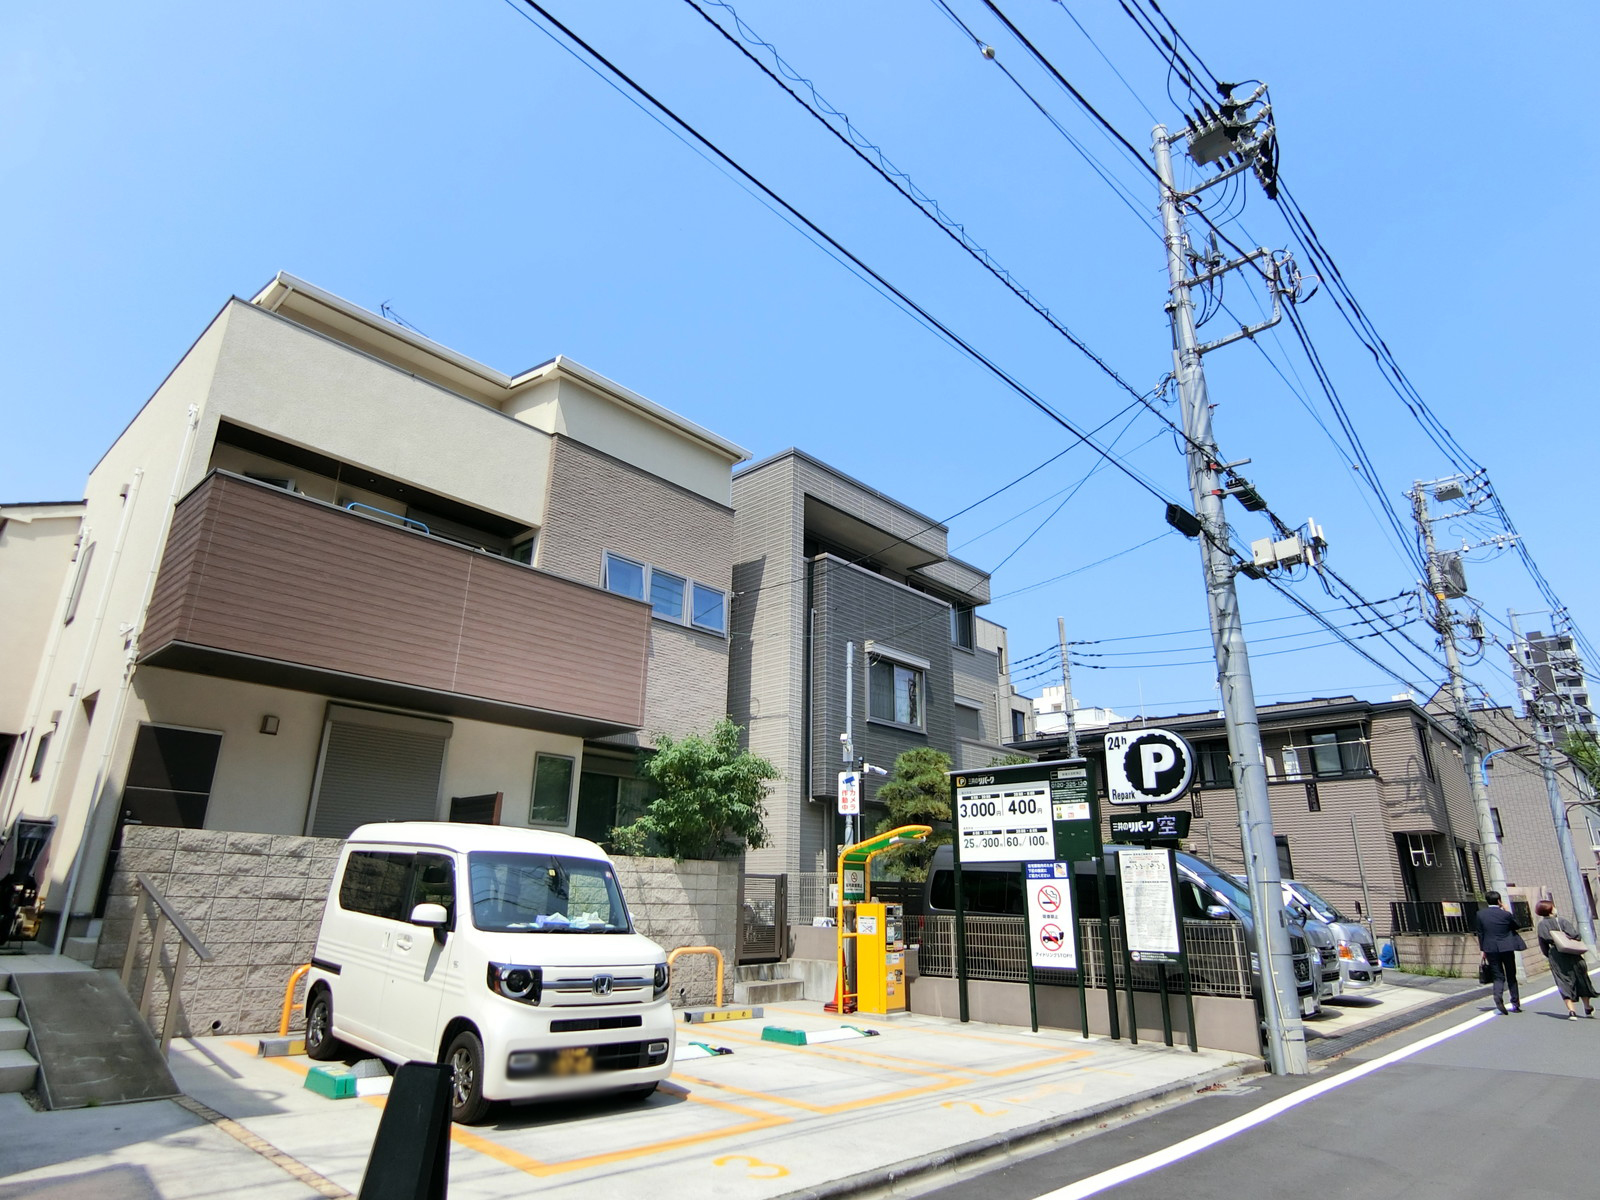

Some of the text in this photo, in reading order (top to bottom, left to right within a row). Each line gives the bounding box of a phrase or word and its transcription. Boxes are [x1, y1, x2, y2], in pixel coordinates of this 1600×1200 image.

[1107, 736, 1127, 751] 24h
[1140, 743, 1175, 789] P
[1112, 789, 1136, 802] Repark
[1112, 820, 1154, 833] 三井のリパーク
[1156, 815, 1178, 835] 空
[712, 1154, 791, 1180] 3
